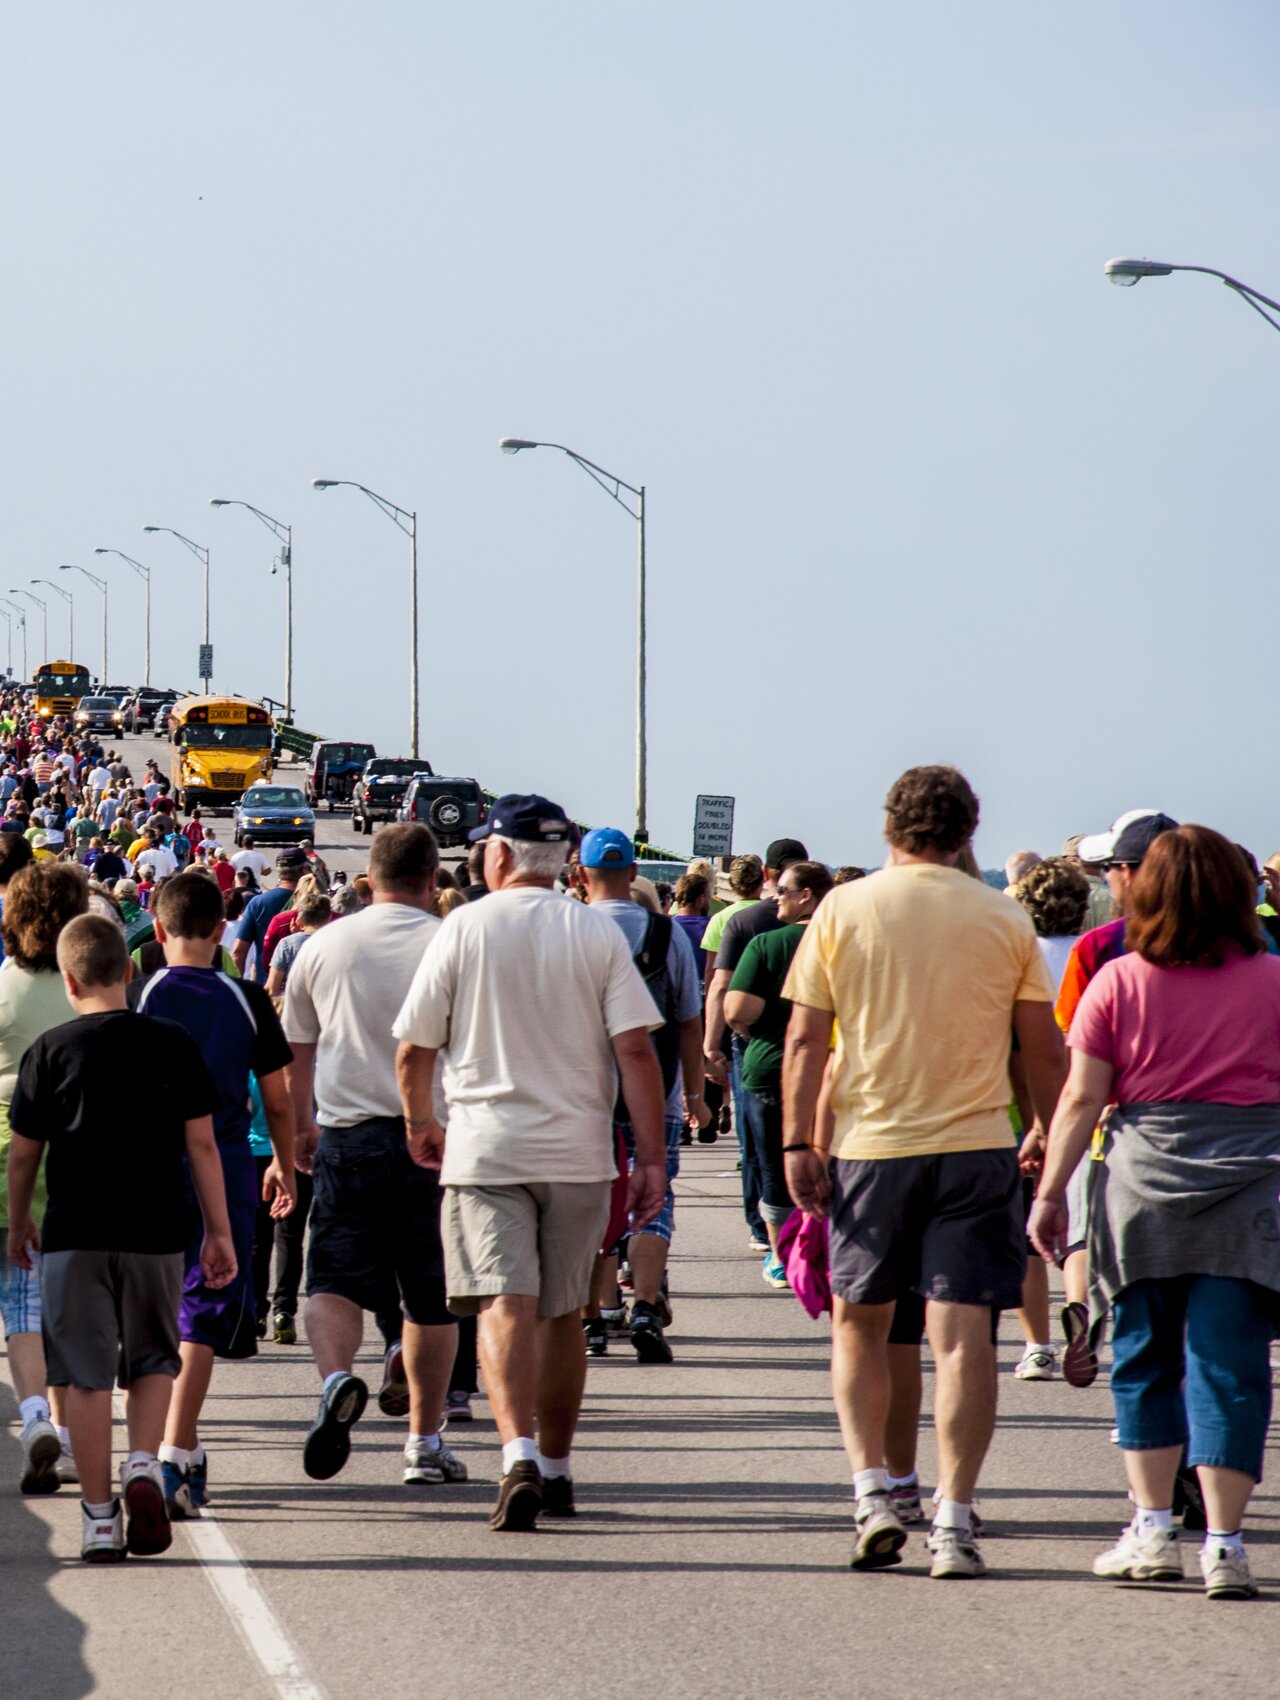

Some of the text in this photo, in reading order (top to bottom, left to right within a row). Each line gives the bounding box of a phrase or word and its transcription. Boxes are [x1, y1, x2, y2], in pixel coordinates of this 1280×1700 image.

[210, 710, 246, 719] SCHOOL BUS
[702, 799, 730, 808] TRAFFIC
[698, 822, 730, 830] DOUBLED
[708, 834, 729, 842] WORK
[95, 1526, 112, 1534] NIKE
